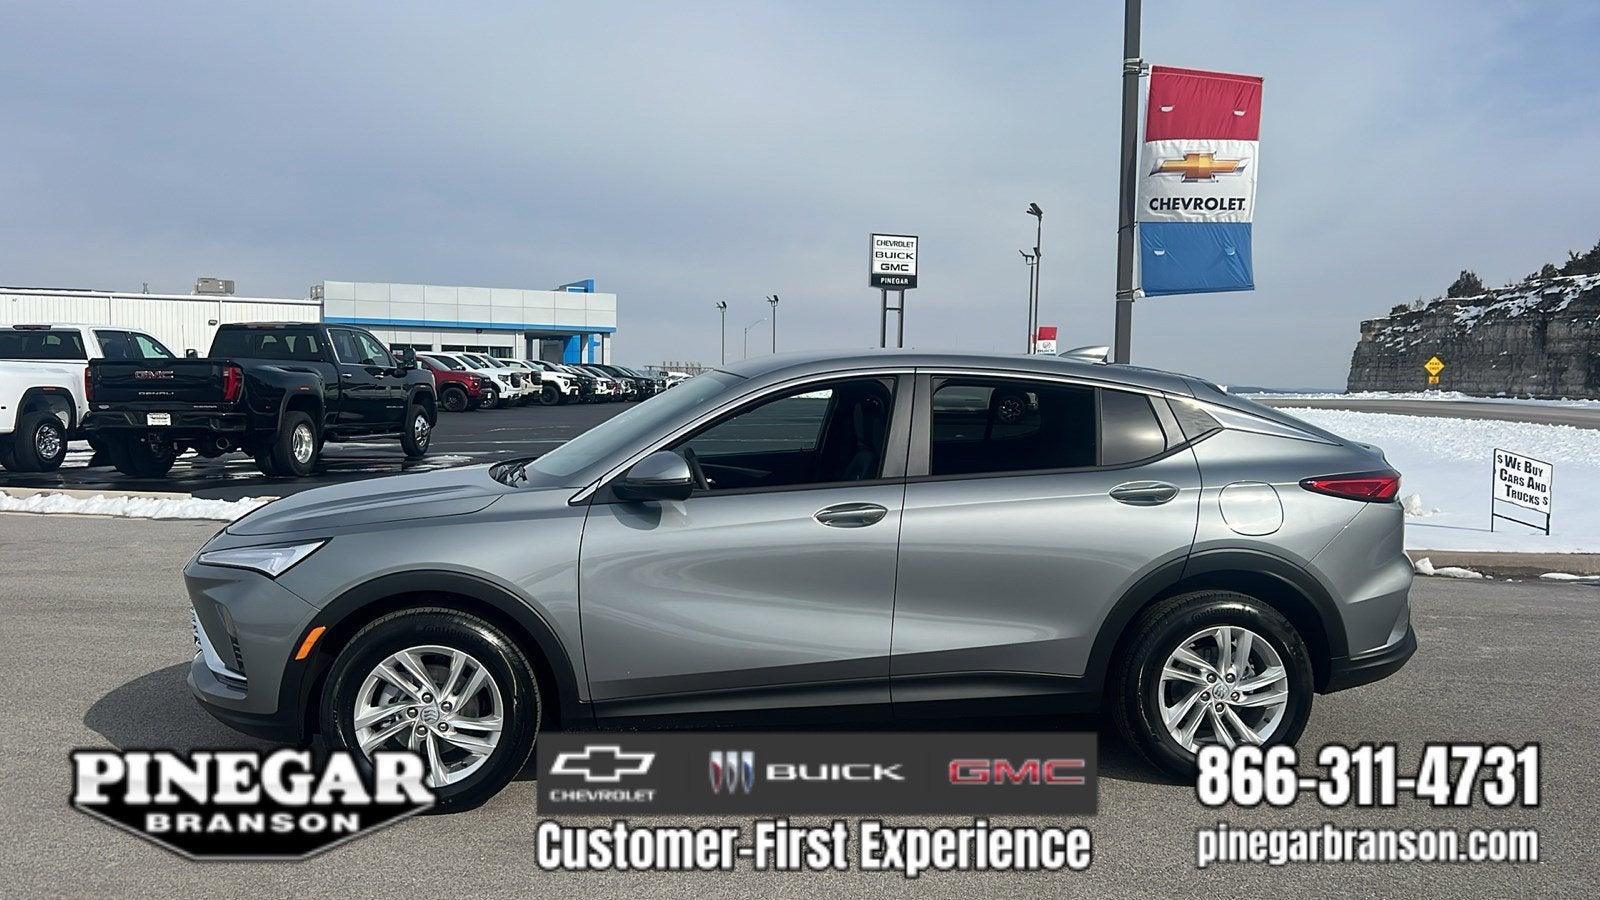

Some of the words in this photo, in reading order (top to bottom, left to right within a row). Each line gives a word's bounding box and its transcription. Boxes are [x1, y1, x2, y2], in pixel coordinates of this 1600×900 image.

[876, 239, 915, 248] CHEVROLET
[875, 251, 914, 260] BUICK
[880, 262, 909, 272] GMC
[880, 277, 909, 285] PINEGAR
[134, 370, 175, 380] GMC
